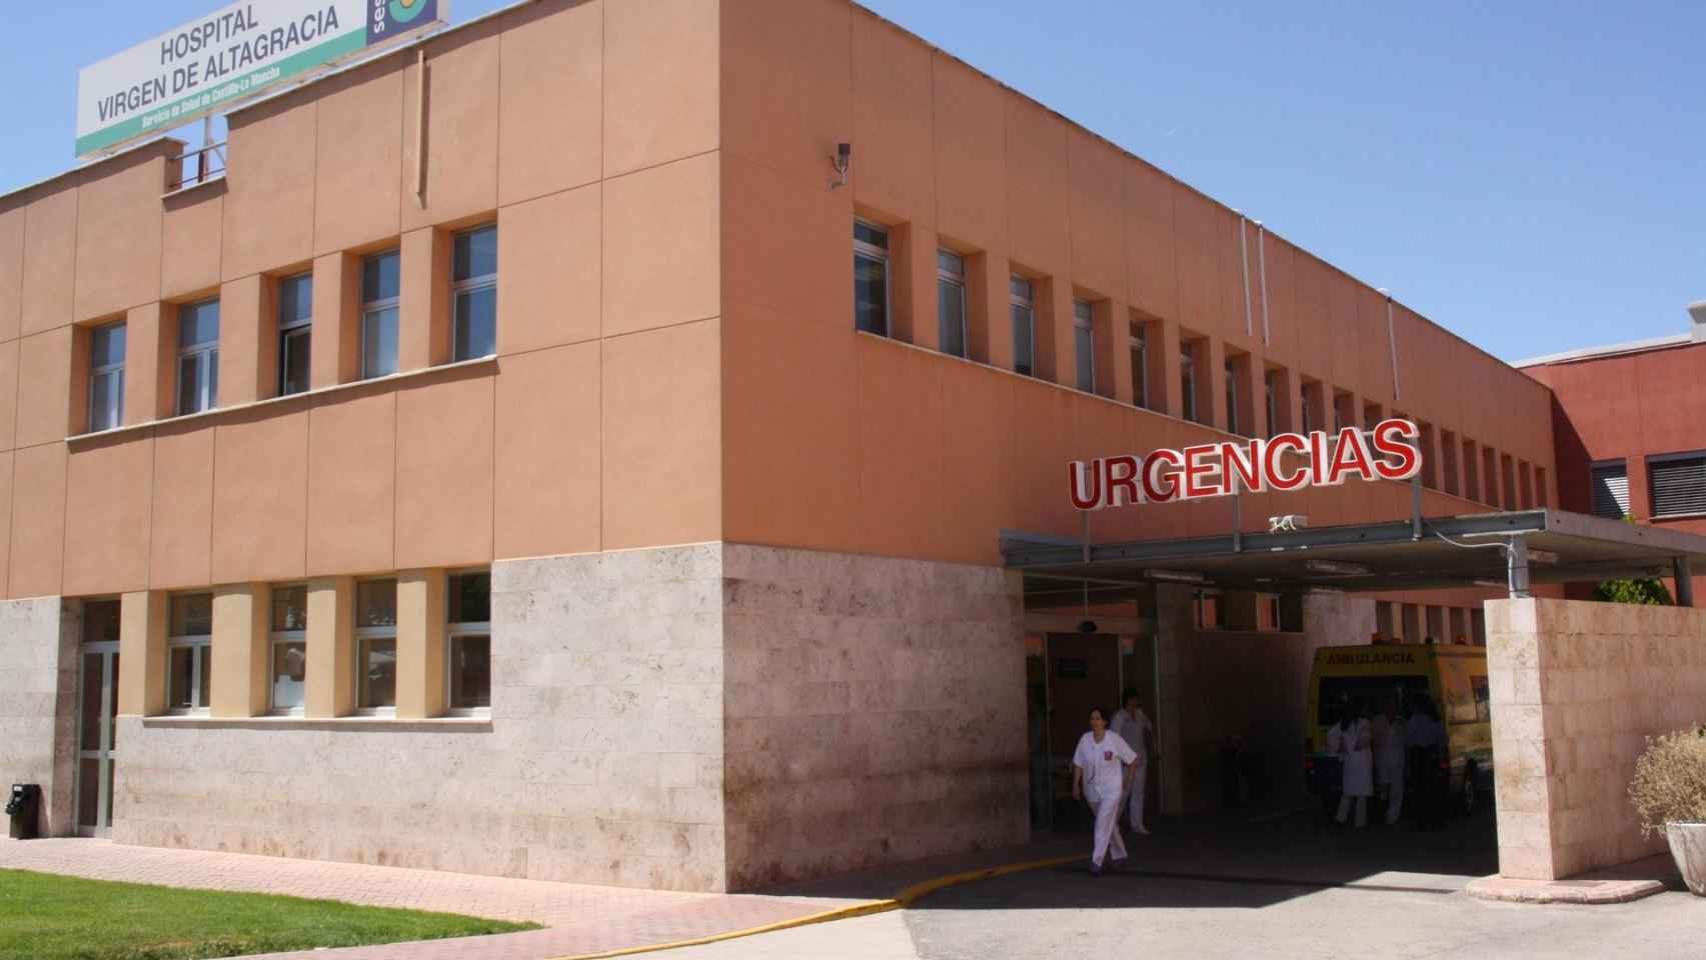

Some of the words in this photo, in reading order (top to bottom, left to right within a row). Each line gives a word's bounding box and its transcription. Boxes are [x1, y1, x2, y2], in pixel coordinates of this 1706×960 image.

[97, 79, 166, 122] VIRGEN
[172, 62, 199, 95] DE
[203, 5, 340, 82] ALTAGRACIA
[160, 5, 259, 65] HOSPITAL
[1068, 419, 1422, 511] URGENCIAS
[1326, 652, 1415, 665] AMBULANCIA
